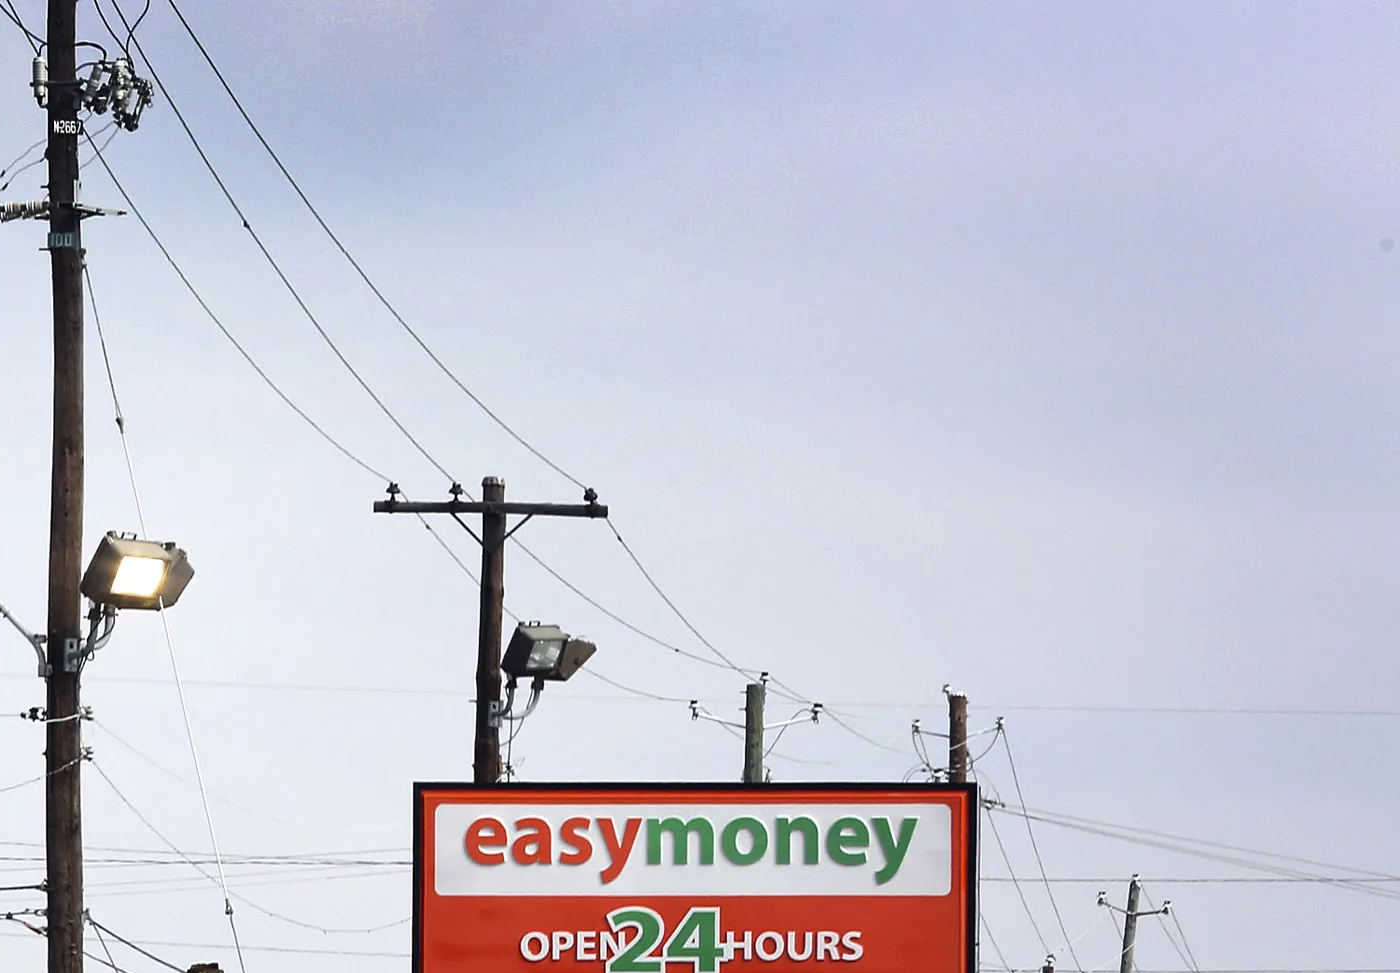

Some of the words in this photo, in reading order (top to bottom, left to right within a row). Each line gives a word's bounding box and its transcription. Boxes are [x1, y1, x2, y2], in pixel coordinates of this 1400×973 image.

[463, 813, 919, 885] easymoney
[520, 931, 627, 961] OPEN
[726, 931, 864, 961] HOURS
